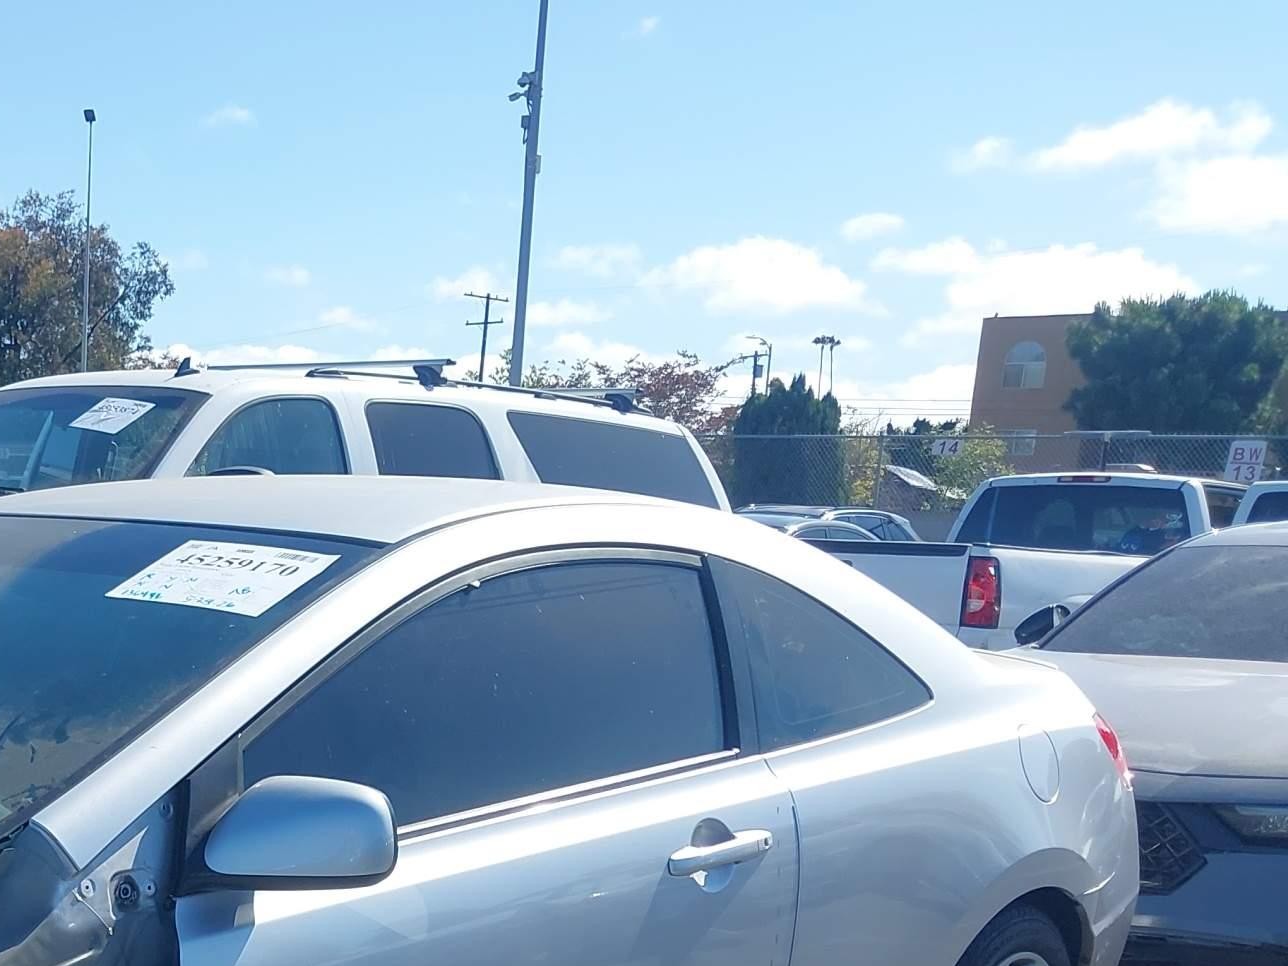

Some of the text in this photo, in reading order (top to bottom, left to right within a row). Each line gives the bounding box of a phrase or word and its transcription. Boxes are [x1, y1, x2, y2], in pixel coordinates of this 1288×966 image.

[938, 440, 959, 455] 14
[1232, 465, 1256, 481] 13
[175, 553, 301, 577] 45259170
